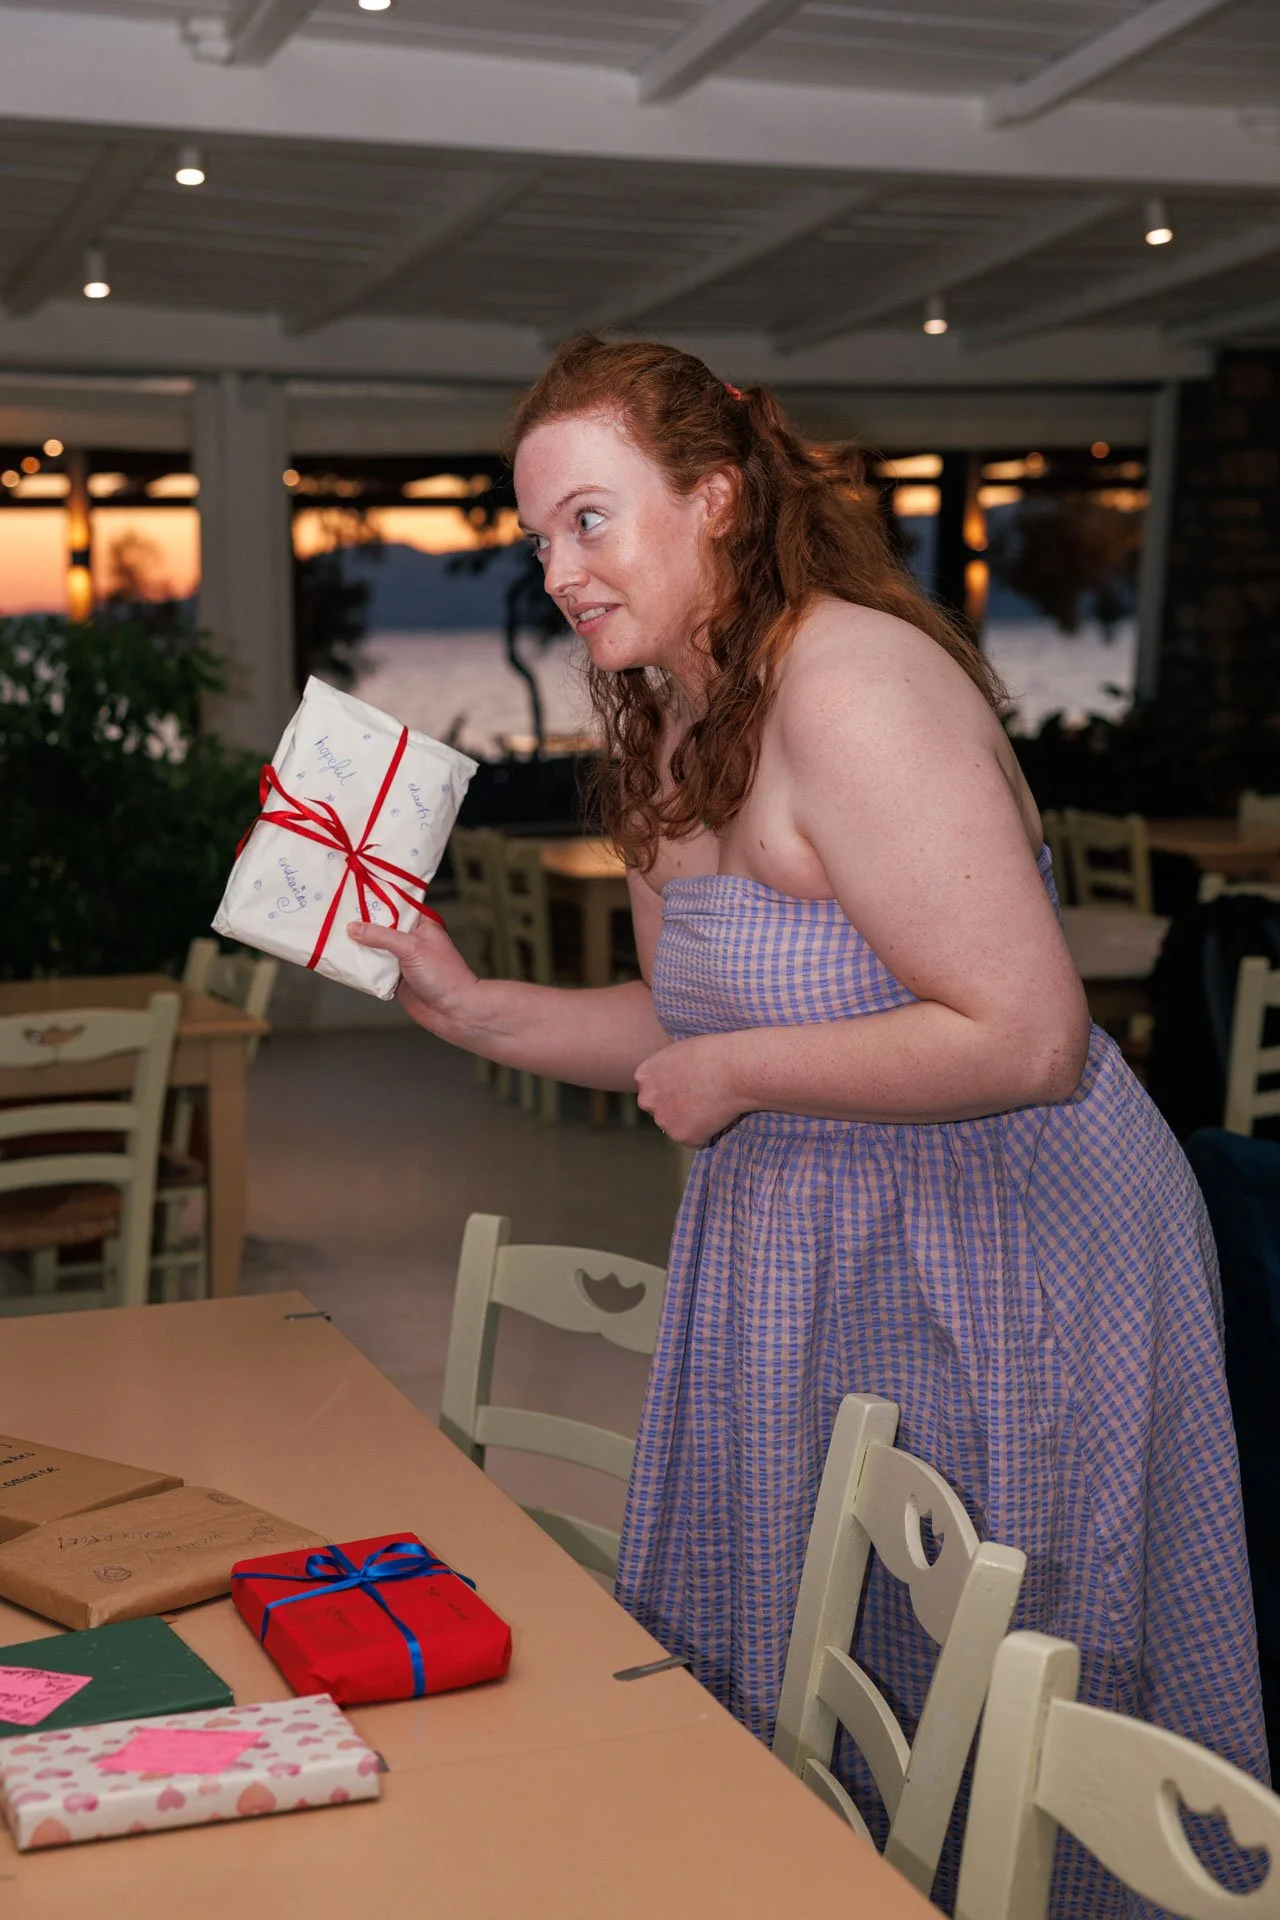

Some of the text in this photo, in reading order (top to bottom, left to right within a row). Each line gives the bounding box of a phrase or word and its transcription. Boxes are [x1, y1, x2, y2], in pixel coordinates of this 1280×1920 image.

[314, 735, 359, 787] hopeful
[408, 782, 430, 830] chaotic
[276, 856, 308, 914] endearing
